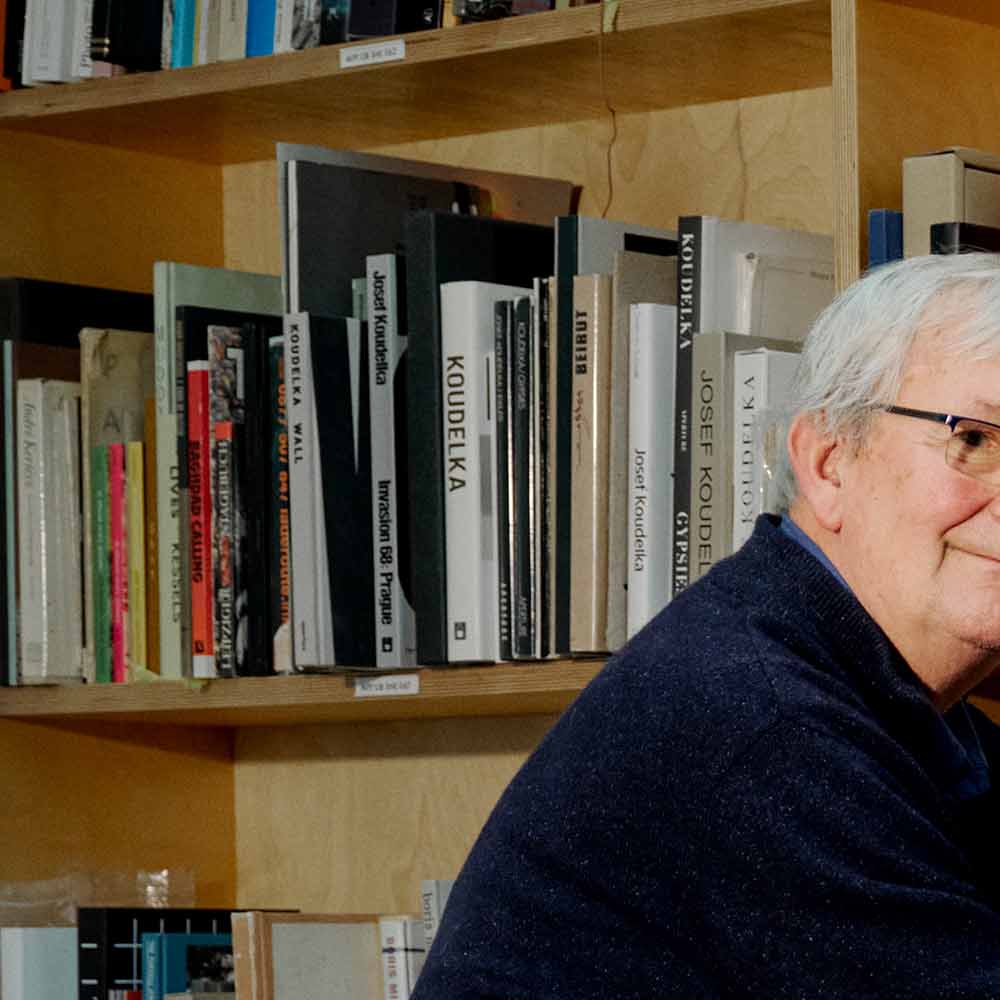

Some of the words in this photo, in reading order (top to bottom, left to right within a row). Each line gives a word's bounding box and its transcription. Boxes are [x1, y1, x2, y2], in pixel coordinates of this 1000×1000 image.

[373, 270, 387, 311] Josef
[679, 232, 696, 351] KOUDELKA
[290, 324, 302, 407] KOUDELKA
[373, 314, 389, 386] Koudelka
[575, 311, 588, 376] BEIRUT
[293, 423, 303, 464] WALL
[447, 355, 468, 494] KOUDELKA
[700, 369, 715, 457] JOSEF
[632, 449, 647, 492] Josef
[377, 479, 393, 543] Invasion
[633, 495, 648, 573] Koudelka
[191, 520, 203, 584] CALLING
[378, 570, 394, 625] Prague
